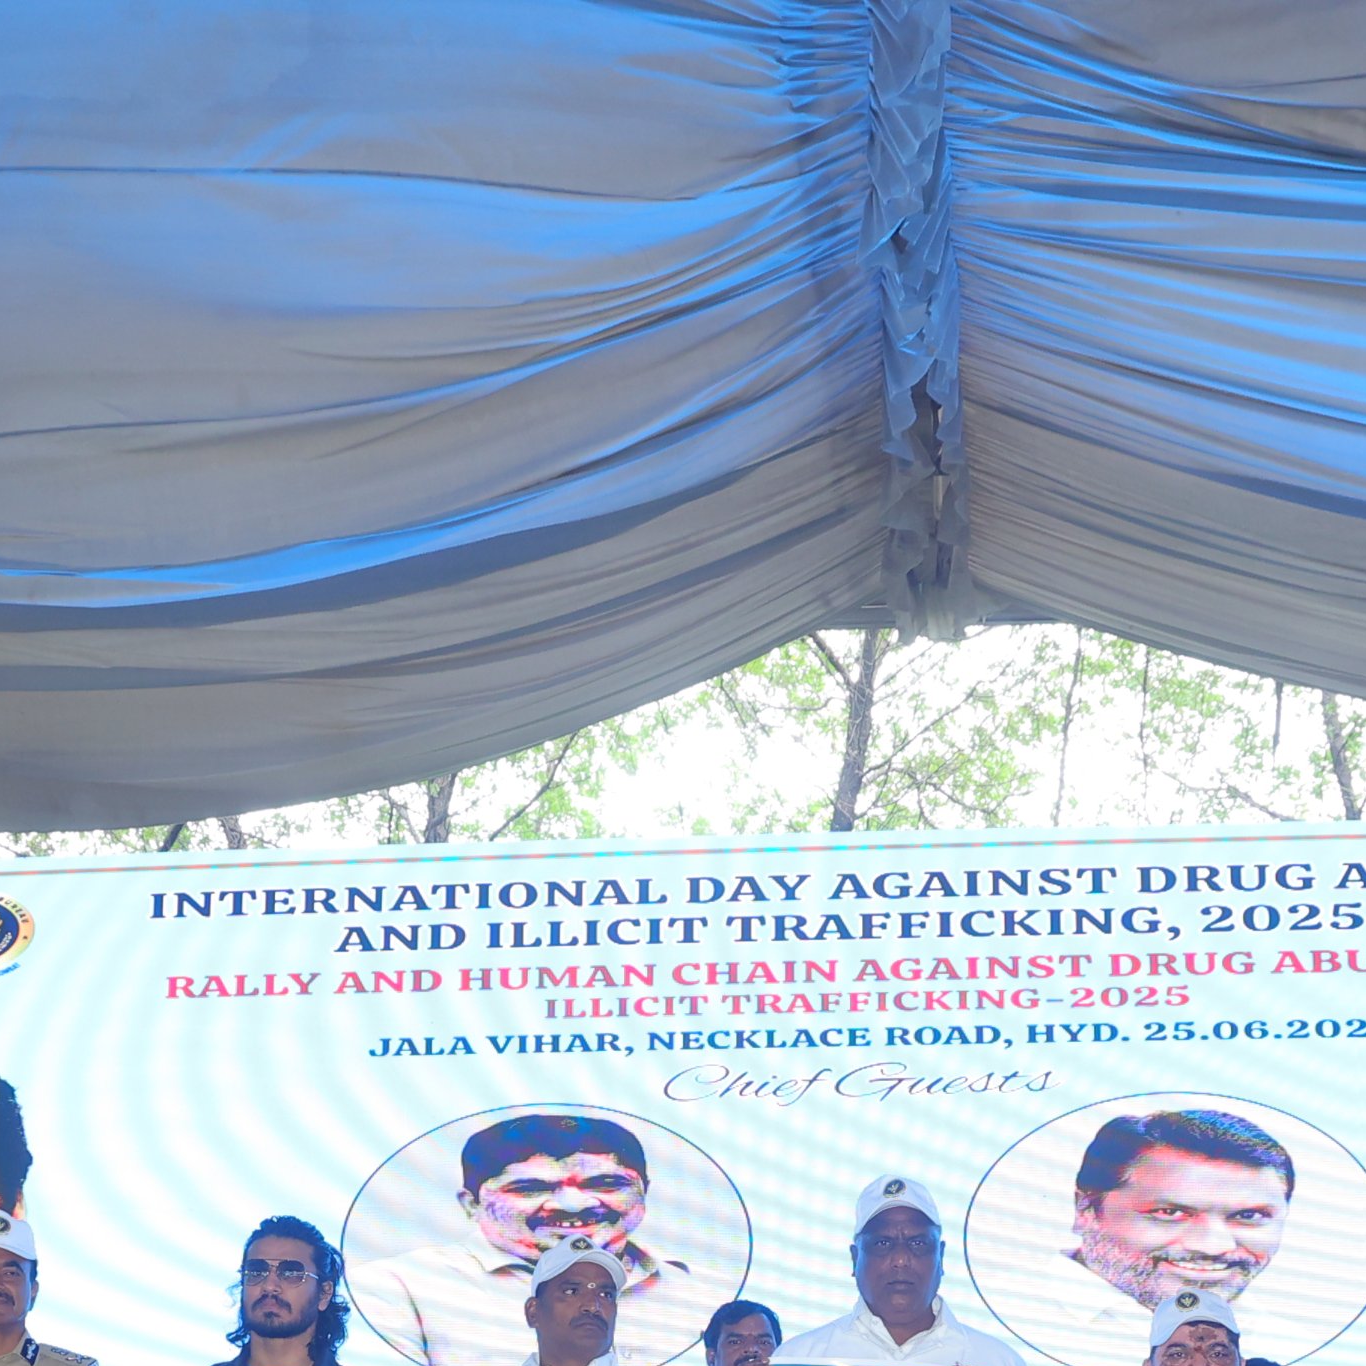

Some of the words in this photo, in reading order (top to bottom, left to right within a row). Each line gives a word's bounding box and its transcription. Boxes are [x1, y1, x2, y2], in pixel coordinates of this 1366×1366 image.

[150, 876, 667, 919] INTERNATIONAL
[685, 874, 812, 903] DAY
[829, 866, 1117, 901] AGAINST
[1136, 862, 1315, 894] DRUG
[333, 923, 467, 953] AND
[485, 917, 708, 949] ILLICIT
[726, 908, 1182, 943] TRAFFICKING,
[1199, 903, 1366, 934] 2025
[165, 971, 321, 999] RALLY
[333, 968, 443, 995] AND
[458, 963, 657, 991] HUMAN
[671, 959, 839, 986] CHAIN
[857, 952, 1093, 981] AGAINST
[1108, 950, 1255, 978] DRUG
[544, 995, 709, 1020] ILLICIT
[721, 984, 1191, 1016] TRAFFICKING-2025
[369, 1034, 473, 1058] JALA
[485, 1031, 634, 1057] VIHAR,
[647, 1027, 871, 1052] NECKLACE
[885, 1025, 1013, 1050] ROAD,
[1026, 1021, 1130, 1045] HYD.
[663, 1064, 829, 1107] Chief
[834, 1060, 1060, 1102] Guests
